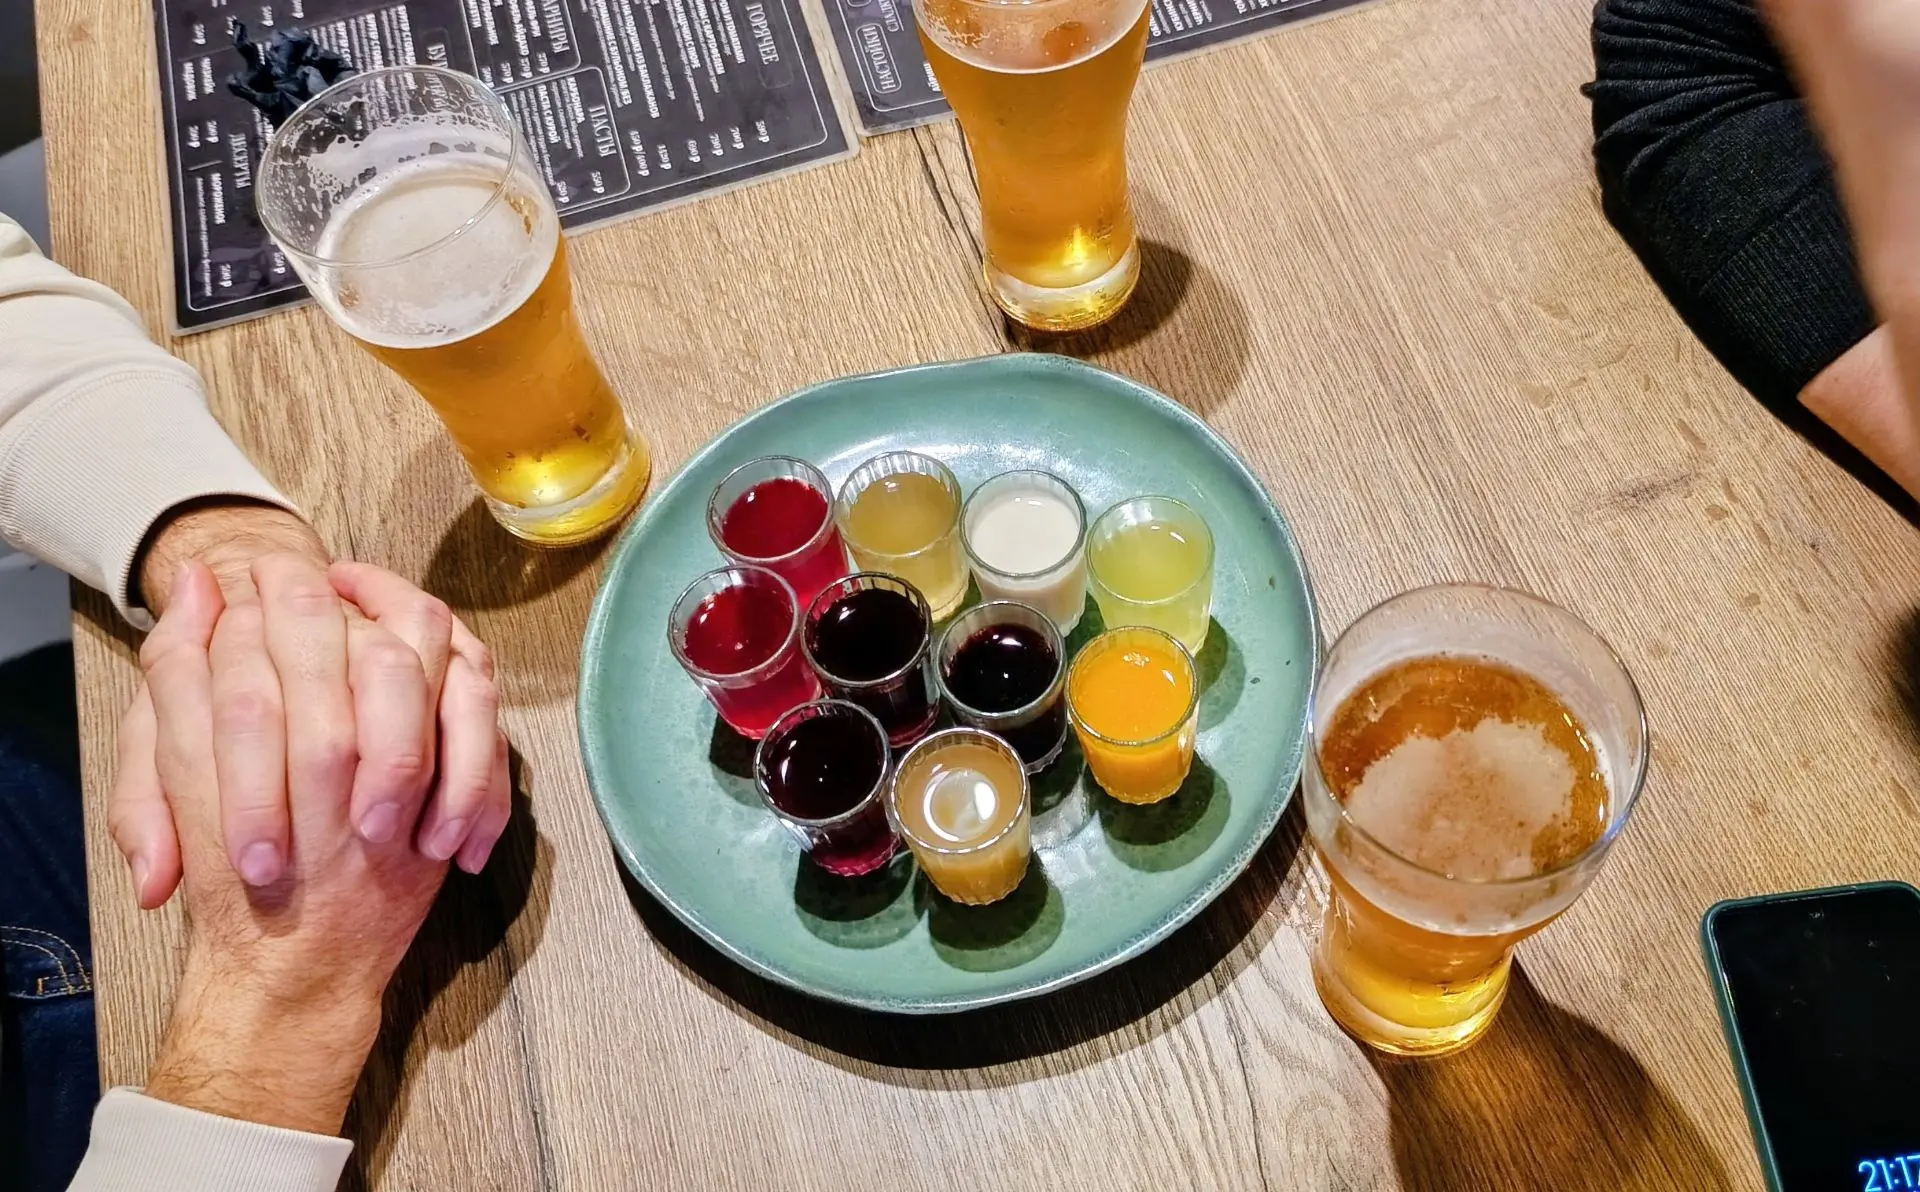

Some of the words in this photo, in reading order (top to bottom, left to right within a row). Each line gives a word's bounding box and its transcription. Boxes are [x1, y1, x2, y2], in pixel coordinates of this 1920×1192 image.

[621, 4, 631, 16] НА
[622, 14, 642, 53] ПОДУШКЕ
[722, 13, 732, 21] И
[744, 2, 781, 65] ГОРЯЧЕЕ
[512, 22, 531, 57] АЙДАХО
[676, 12, 692, 41] ЩЕЧКИ
[686, 46, 700, 69] ПЮРЕ
[701, 24, 725, 75] КАРТОФЕЛЕМ
[724, 20, 746, 63] ТОМАТАМИ
[860, 25, 896, 90] НАСТОЙКИ
[537, 84, 551, 110] ПАСТА
[543, 109, 552, 117] С
[566, 76, 585, 123] КАРБОНАРА
[636, 63, 660, 119] БАКЛАЖАНОВ
[543, 115, 561, 144] КУРОЙ
[588, 104, 617, 157] ПАСТЫ
[228, 131, 250, 190] ДЕСЕРТЫ
[210, 171, 225, 225] МОРОЖЕНОЕ
